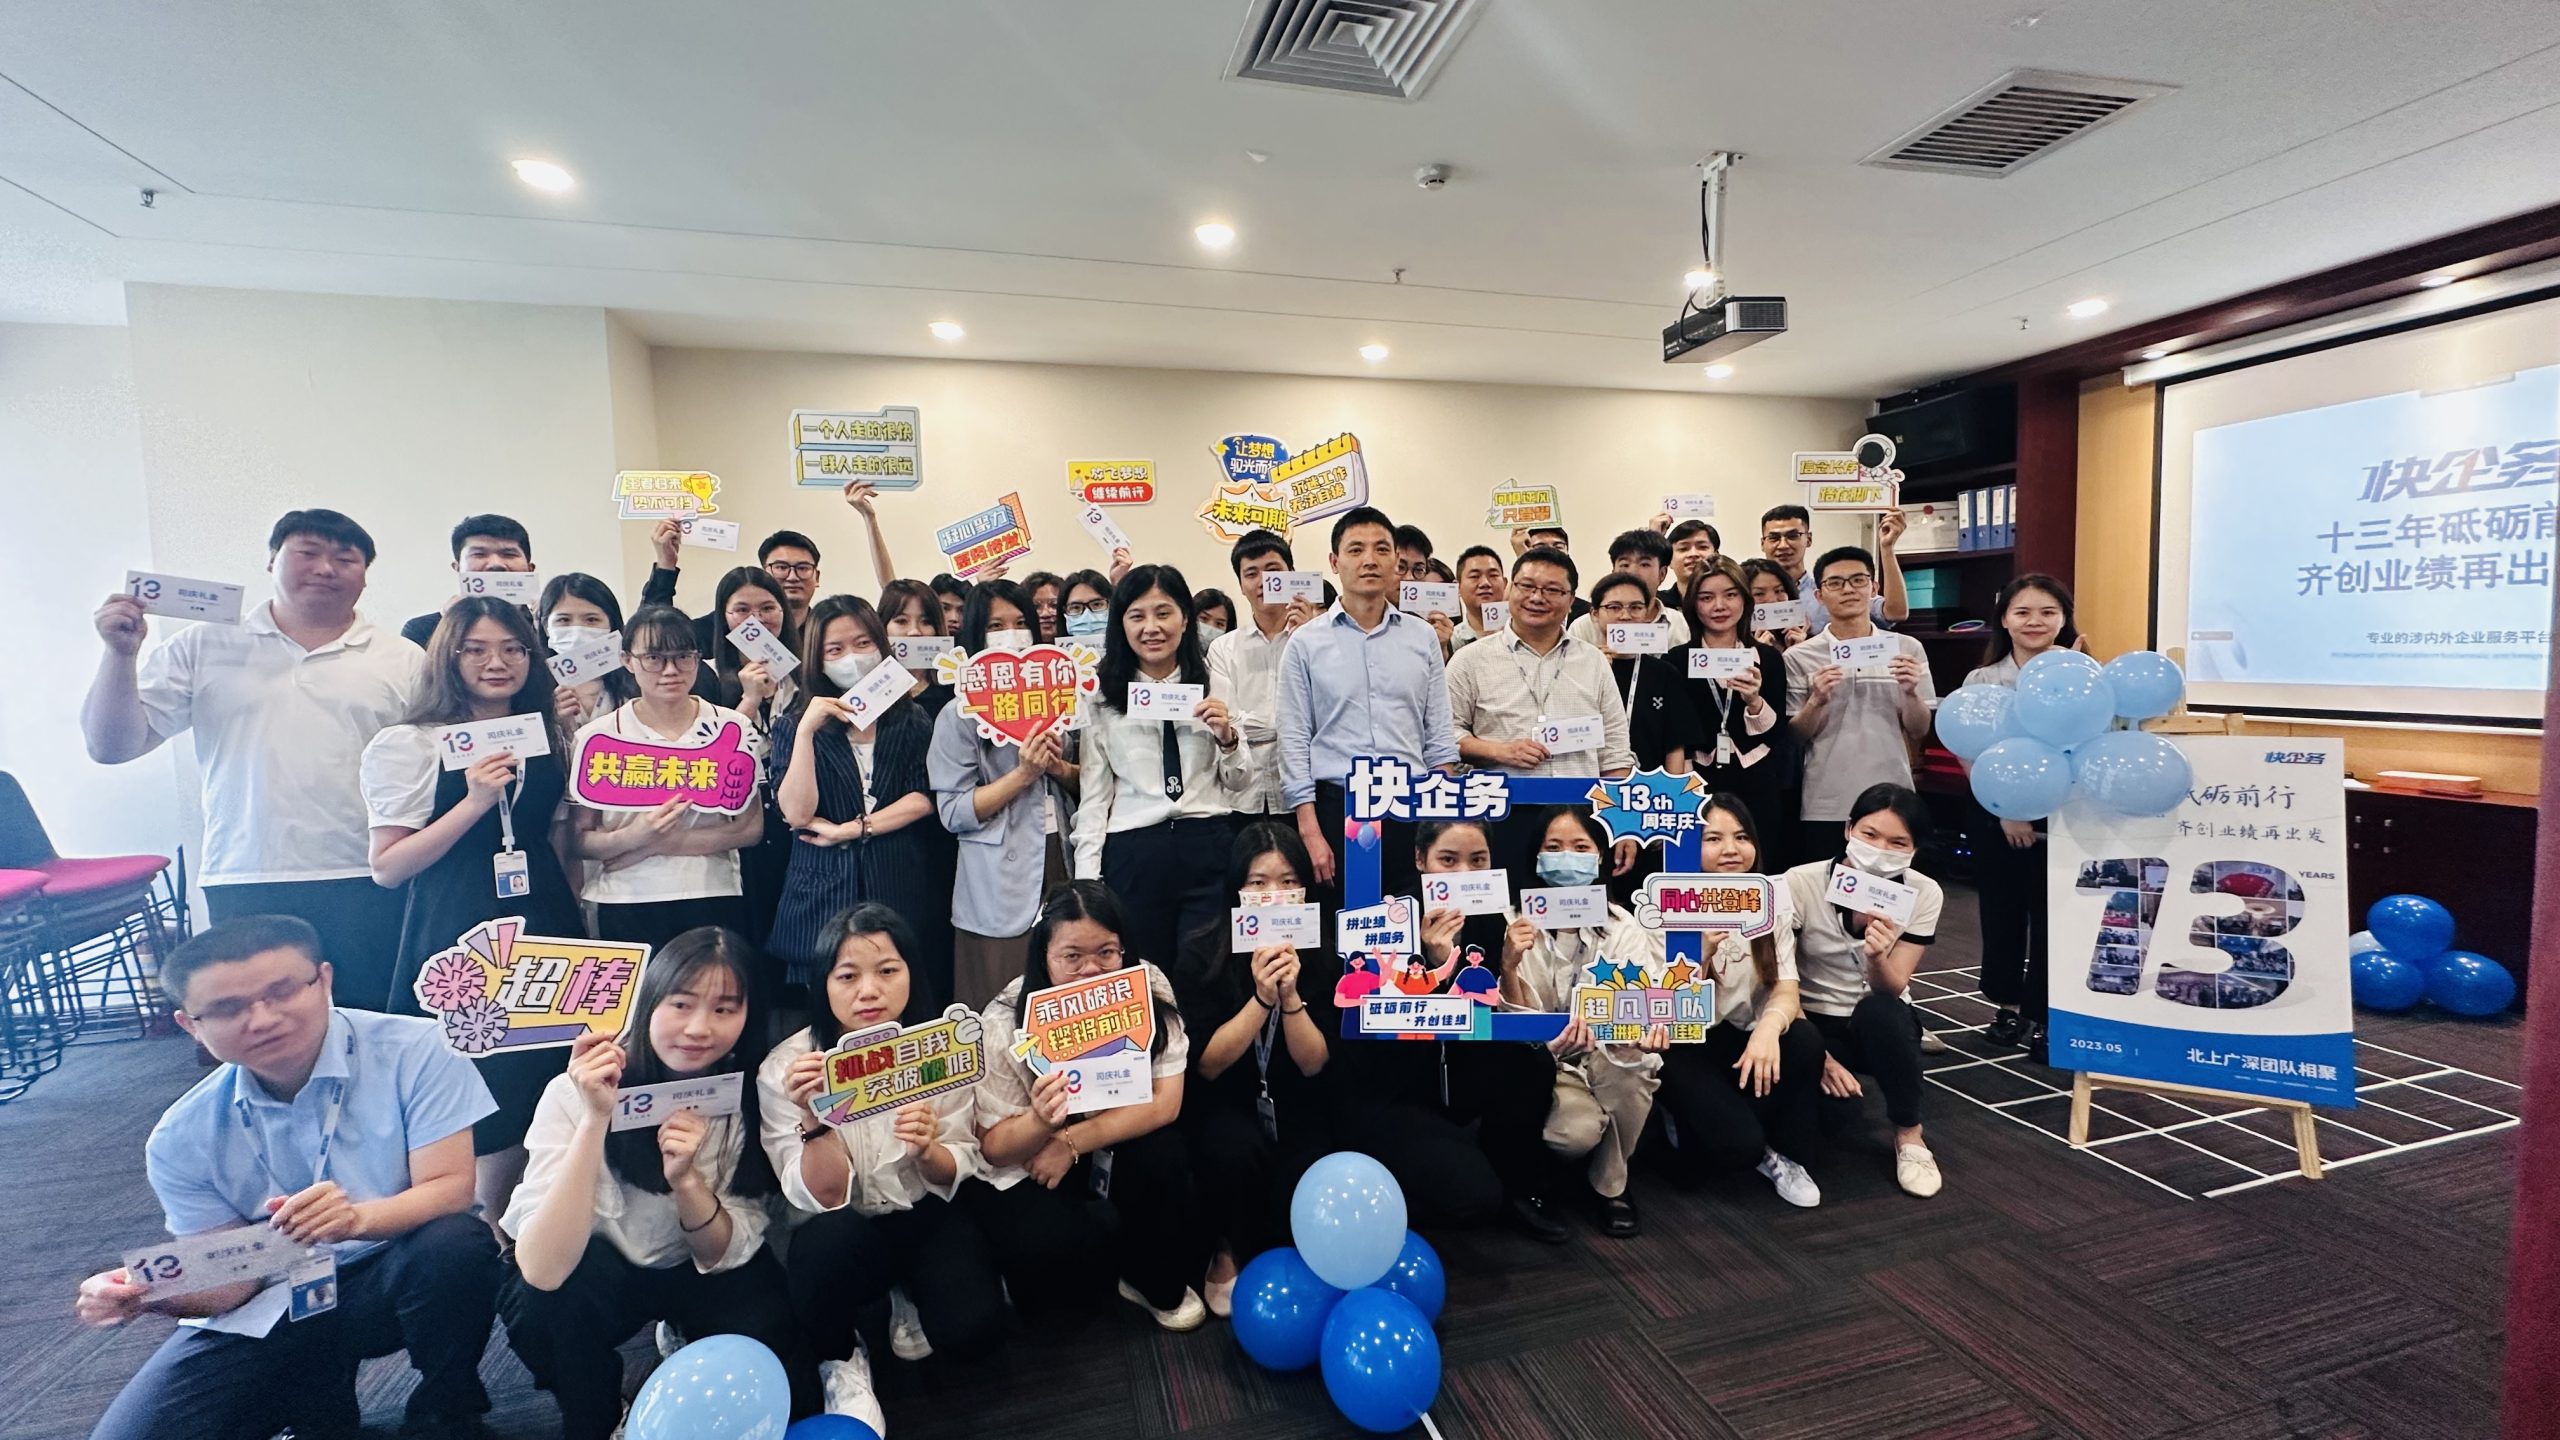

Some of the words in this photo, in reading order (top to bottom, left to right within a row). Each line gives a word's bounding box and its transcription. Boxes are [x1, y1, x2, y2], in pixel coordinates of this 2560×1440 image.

[803, 419, 913, 441] 一个人走的很快
[1234, 441, 1275, 459] 让梦想
[805, 455, 913, 475] 一群人走的很远
[1090, 466, 1148, 481] 放飞梦想
[2356, 439, 2560, 503] 快企务
[1291, 465, 1347, 497] 沉迷工作
[633, 495, 695, 511] 势不可挡
[1092, 486, 1145, 500] 继续前行
[1289, 482, 1346, 513] 无法自拔
[1212, 499, 1287, 531] 未来可期
[942, 510, 1008, 547] 凝心聚力
[2297, 549, 2549, 596] 齐创业绩再出
[130, 577, 161, 600] 13
[462, 577, 484, 593] 13
[1265, 577, 1282, 592] 13
[1402, 585, 1418, 601] 13
[1484, 607, 1498, 621] 13
[1609, 628, 1625, 642] 13
[2366, 631, 2552, 645] 专业的涉内外企业服务平台
[1691, 653, 1708, 667] 13
[1833, 645, 1851, 659] 13
[553, 658, 577, 677] 13
[959, 657, 1075, 693] 感恩有你
[963, 687, 1077, 723] 一路同行
[1131, 688, 1151, 706] 13
[443, 731, 473, 754] 13
[1541, 727, 1558, 743] 13
[2264, 752, 2327, 765] 快企务
[587, 752, 719, 791] 共赢未来
[1350, 761, 1509, 818] 快企务
[1642, 813, 1696, 830] 周年庆
[2177, 820, 2325, 844] 齐创业绩再出发
[1835, 872, 1858, 894] 13
[2299, 871, 2336, 880] YEARS
[1425, 880, 1449, 901] 13
[1660, 887, 1761, 913] 同心共登峰
[1525, 895, 1548, 915] 13
[1236, 915, 1259, 936] 13
[1346, 916, 1386, 930] 拼业绩
[2075, 857, 2305, 1009] 13
[1365, 931, 1404, 946] 拼服务
[494, 956, 637, 1015] 超棒
[1035, 977, 1133, 1027] 乘风破浪
[1369, 1001, 1428, 1015] 砥砺前行
[1584, 997, 1705, 1019] 超凡团队
[1047, 1002, 1145, 1051] 铿锵前行
[1414, 1015, 1467, 1027] 齐创佳绩
[1592, 1024, 1704, 1041] 结拼搏佳绩
[2070, 1038, 2122, 1053] 2023.05
[835, 1029, 950, 1084] 挑战自我
[2187, 1048, 2337, 1080] 北上广深团队相聚
[864, 1050, 974, 1102] 突破极限
[618, 1093, 653, 1116] 13
[134, 1255, 182, 1282] 13
